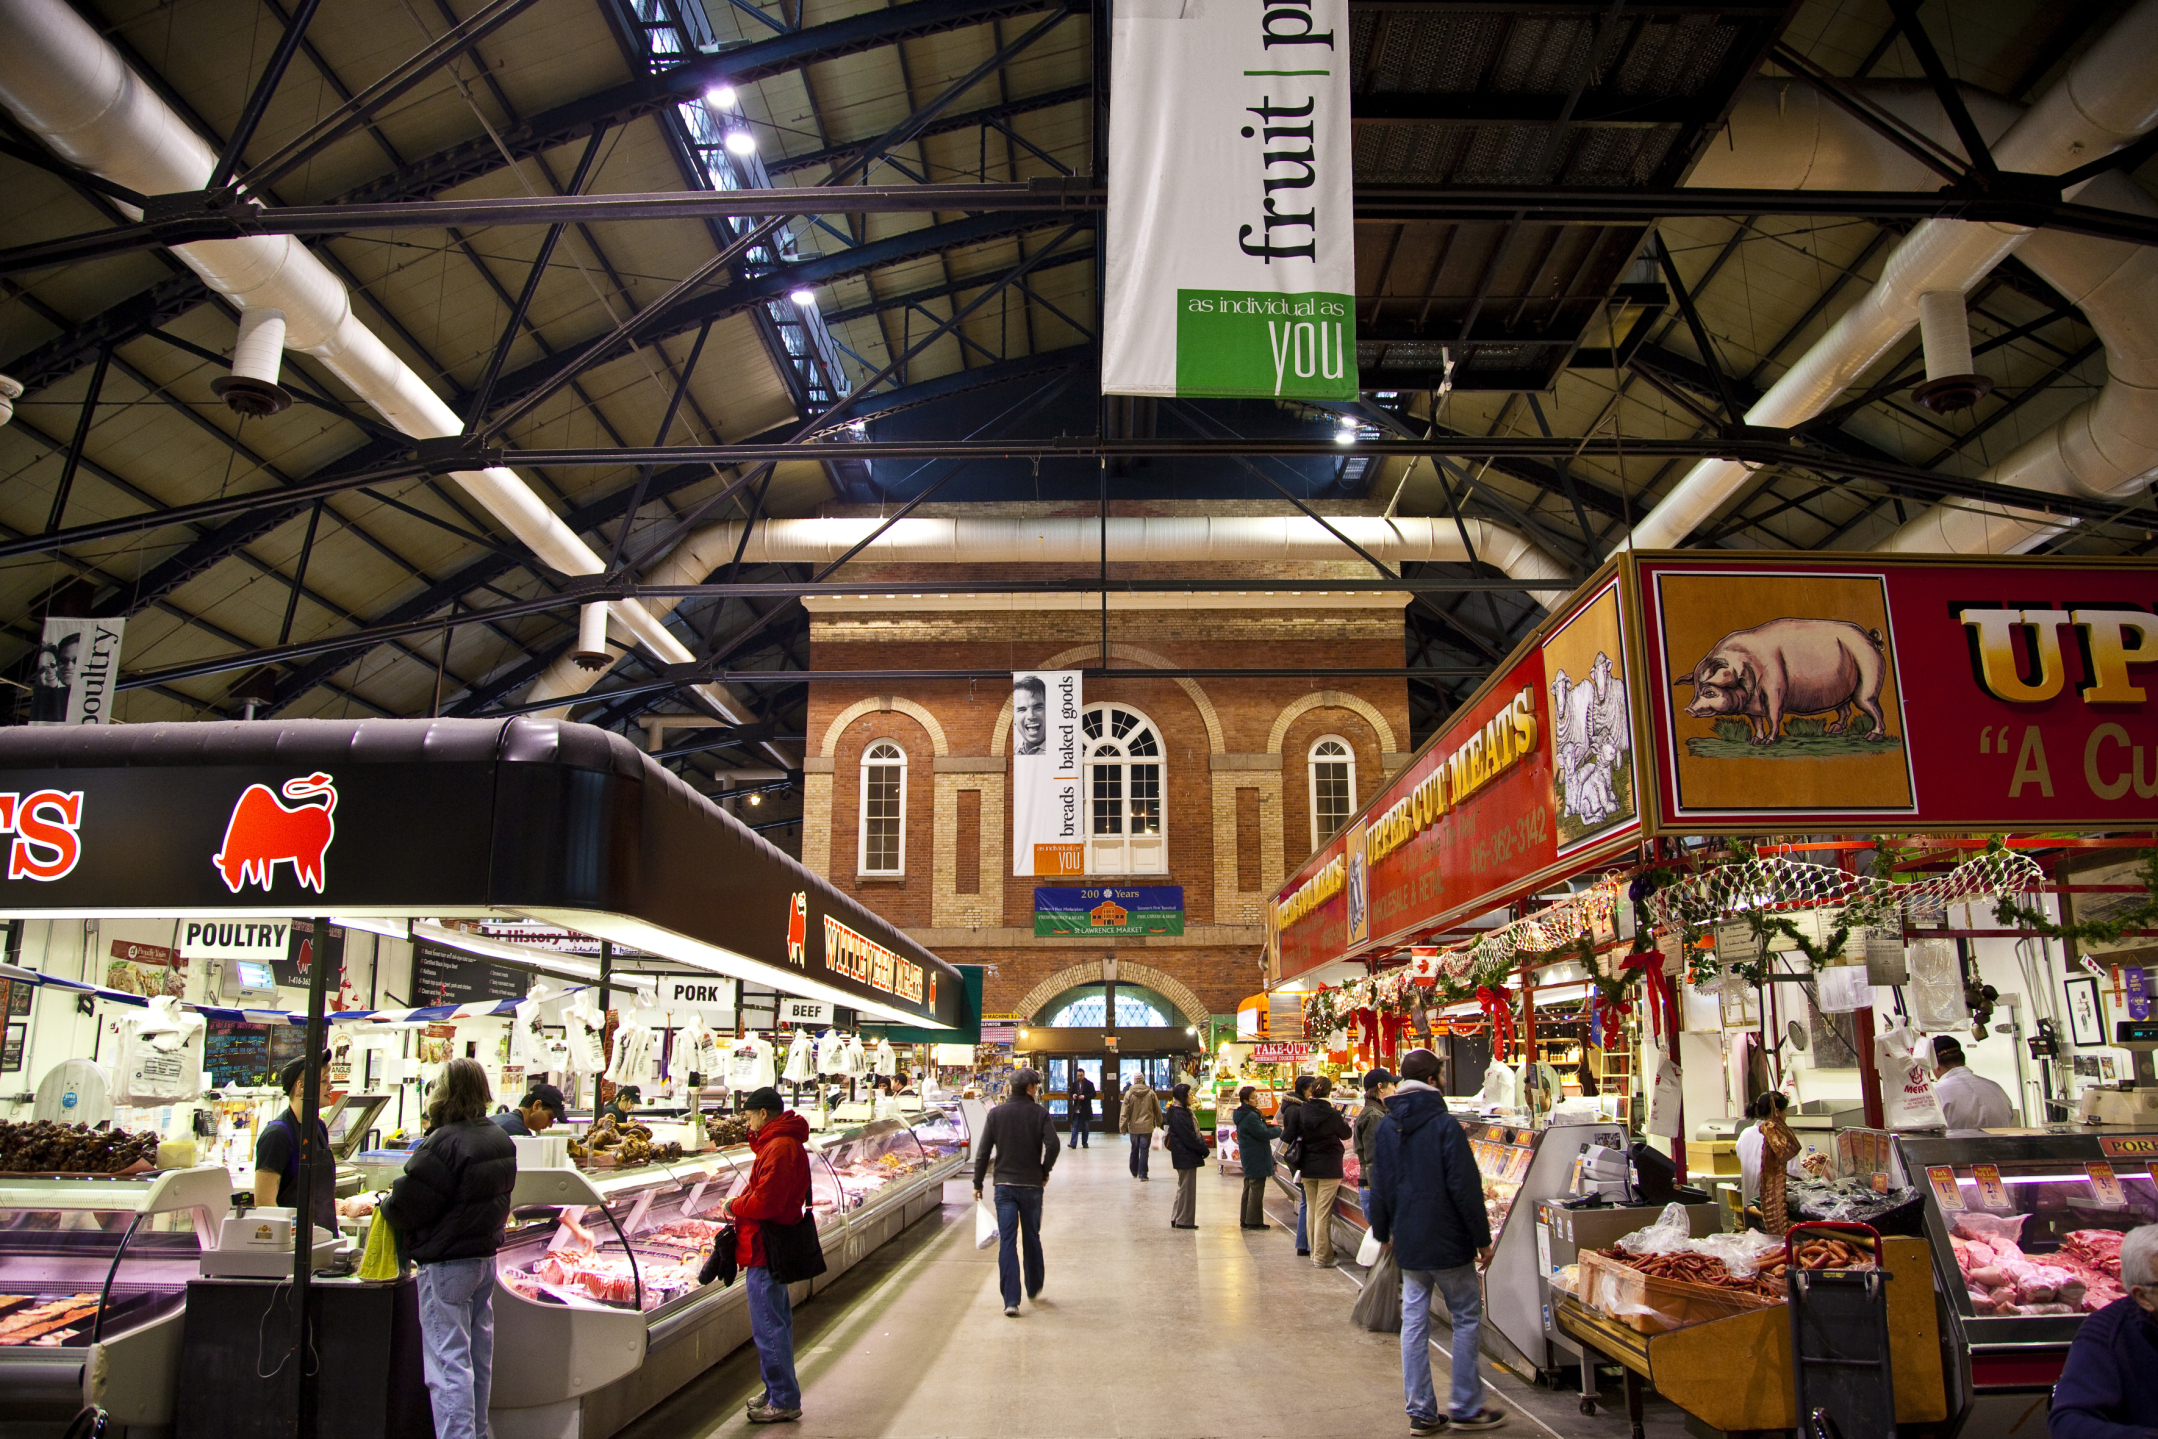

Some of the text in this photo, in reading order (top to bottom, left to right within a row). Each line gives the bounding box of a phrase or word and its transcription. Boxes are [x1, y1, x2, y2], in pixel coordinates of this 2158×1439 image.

[1239, 95, 1316, 265] fruit
[1188, 297, 1345, 317] as individual as
[1267, 320, 1344, 396] you
[1959, 608, 2158, 704] UP
[1058, 675, 1078, 838] breads baked goods
[1365, 686, 1538, 866] UPPER CUT MEATS
[0, 788, 84, 882] S
[1470, 805, 1548, 876] 416-362-3142
[1058, 851, 1080, 875] you
[1313, 852, 1346, 908] MEATS
[1081, 889, 1140, 899] 200 Years
[1372, 867, 1445, 926] WHOLESALE & RETAIL
[186, 922, 288, 948] POULTRY
[506, 930, 562, 945] History
[1116, 926, 1143, 934] MARKET
[823, 913, 923, 1006] WITTEVEEN MEATS
[673, 984, 719, 1002] PORK
[792, 1004, 822, 1018] BEEF
[1255, 1042, 1308, 1055] TAKE-OUT
[1904, 1083, 1930, 1094] MEAT
